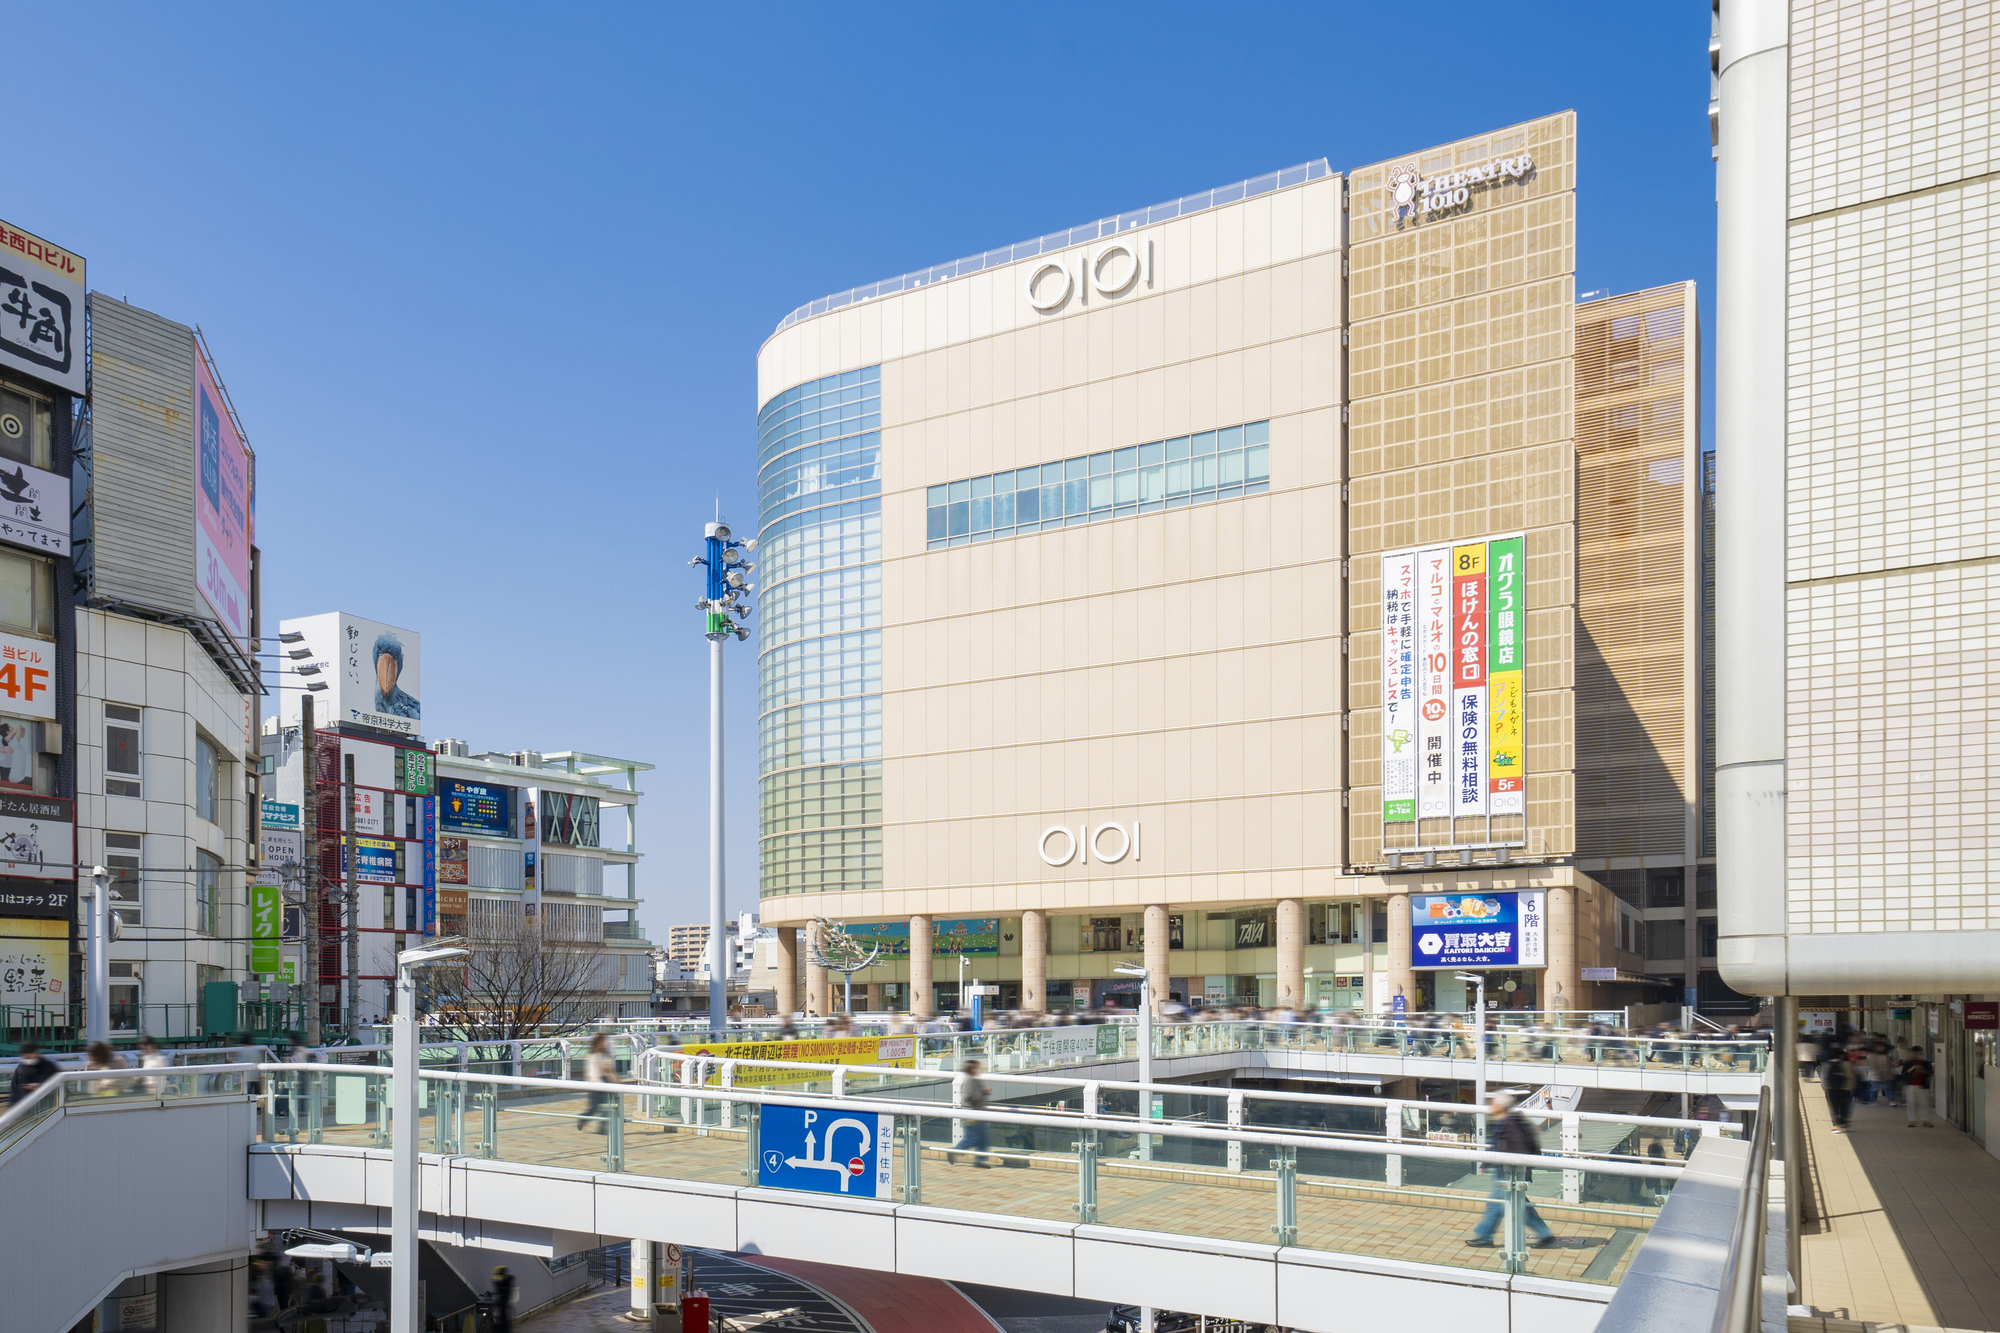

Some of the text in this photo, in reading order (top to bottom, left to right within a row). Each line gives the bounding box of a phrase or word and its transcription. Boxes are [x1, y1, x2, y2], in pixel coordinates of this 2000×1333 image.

[1417, 153, 1532, 196] THEATRE
[1420, 187, 1468, 214] 1010
[1, 288, 63, 353] 牛角
[1, 523, 62, 549] やってます
[1459, 554, 1480, 570] 8F
[207, 547, 227, 611] 30m
[1498, 553, 1515, 664] オグラ眼鏡店
[1400, 565, 1412, 700] スマホで手軽に確定申告
[1461, 581, 1479, 680] ほけんの窓口
[3, 645, 42, 664] 当ビル
[0, 662, 49, 702] 4F
[362, 713, 412, 732] 帝京科学大学
[1510, 681, 1519, 736] こどもメガネ
[1427, 736, 1442, 785] 開催中
[1462, 694, 1479, 804] 保険の無料相談
[407, 751, 416, 791] 金子ビル
[417, 753, 425, 786] 北千住
[1498, 779, 1515, 791] 5F
[262, 804, 287, 812] 現役合格
[1389, 807, 1411, 815] e-Tax
[268, 845, 294, 854] OPEN
[48, 893, 68, 907] 2F
[1524, 900, 1540, 928] 6階
[256, 893, 273, 938] レイク
[1238, 922, 1265, 944] TAYA
[1444, 931, 1511, 949] 買取大吉
[4, 965, 47, 993] 野菜
[804, 1110, 817, 1129] P
[769, 1154, 777, 1167] 4
[879, 1126, 891, 1184] 北千住駅
